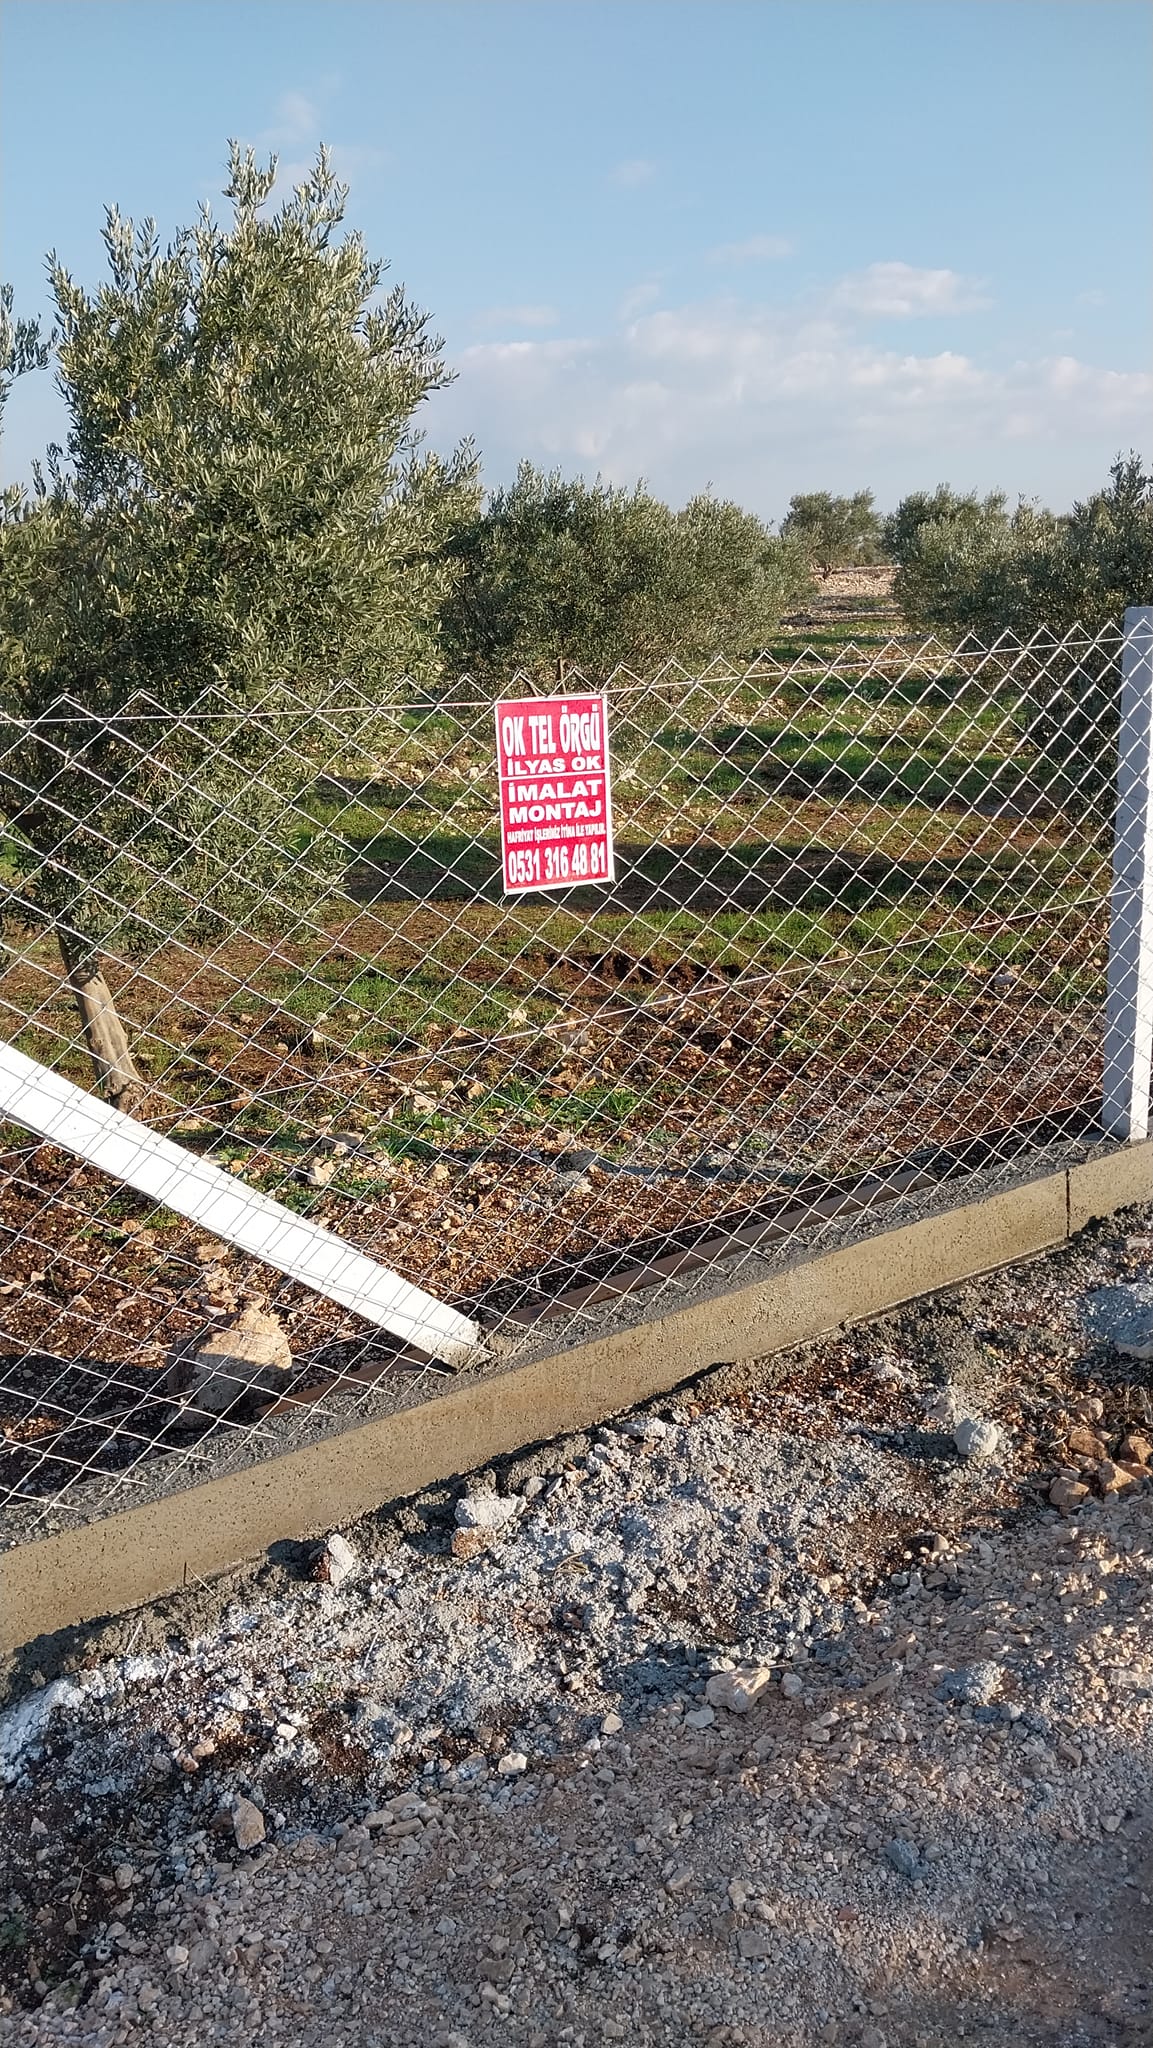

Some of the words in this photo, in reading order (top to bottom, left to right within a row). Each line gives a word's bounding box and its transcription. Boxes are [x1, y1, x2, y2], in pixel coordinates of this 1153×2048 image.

[502, 716, 526, 757] OK
[529, 715, 556, 754] TEL
[560, 704, 600, 756] ÖRGÜ
[507, 758, 566, 776] İLYAS
[571, 756, 601, 771] OK
[508, 780, 602, 802] İMALAT
[509, 800, 602, 824] MONTAJ
[508, 848, 540, 883] 0531
[544, 845, 569, 879] 316
[572, 844, 588, 876] 48
[591, 841, 606, 874] 81
